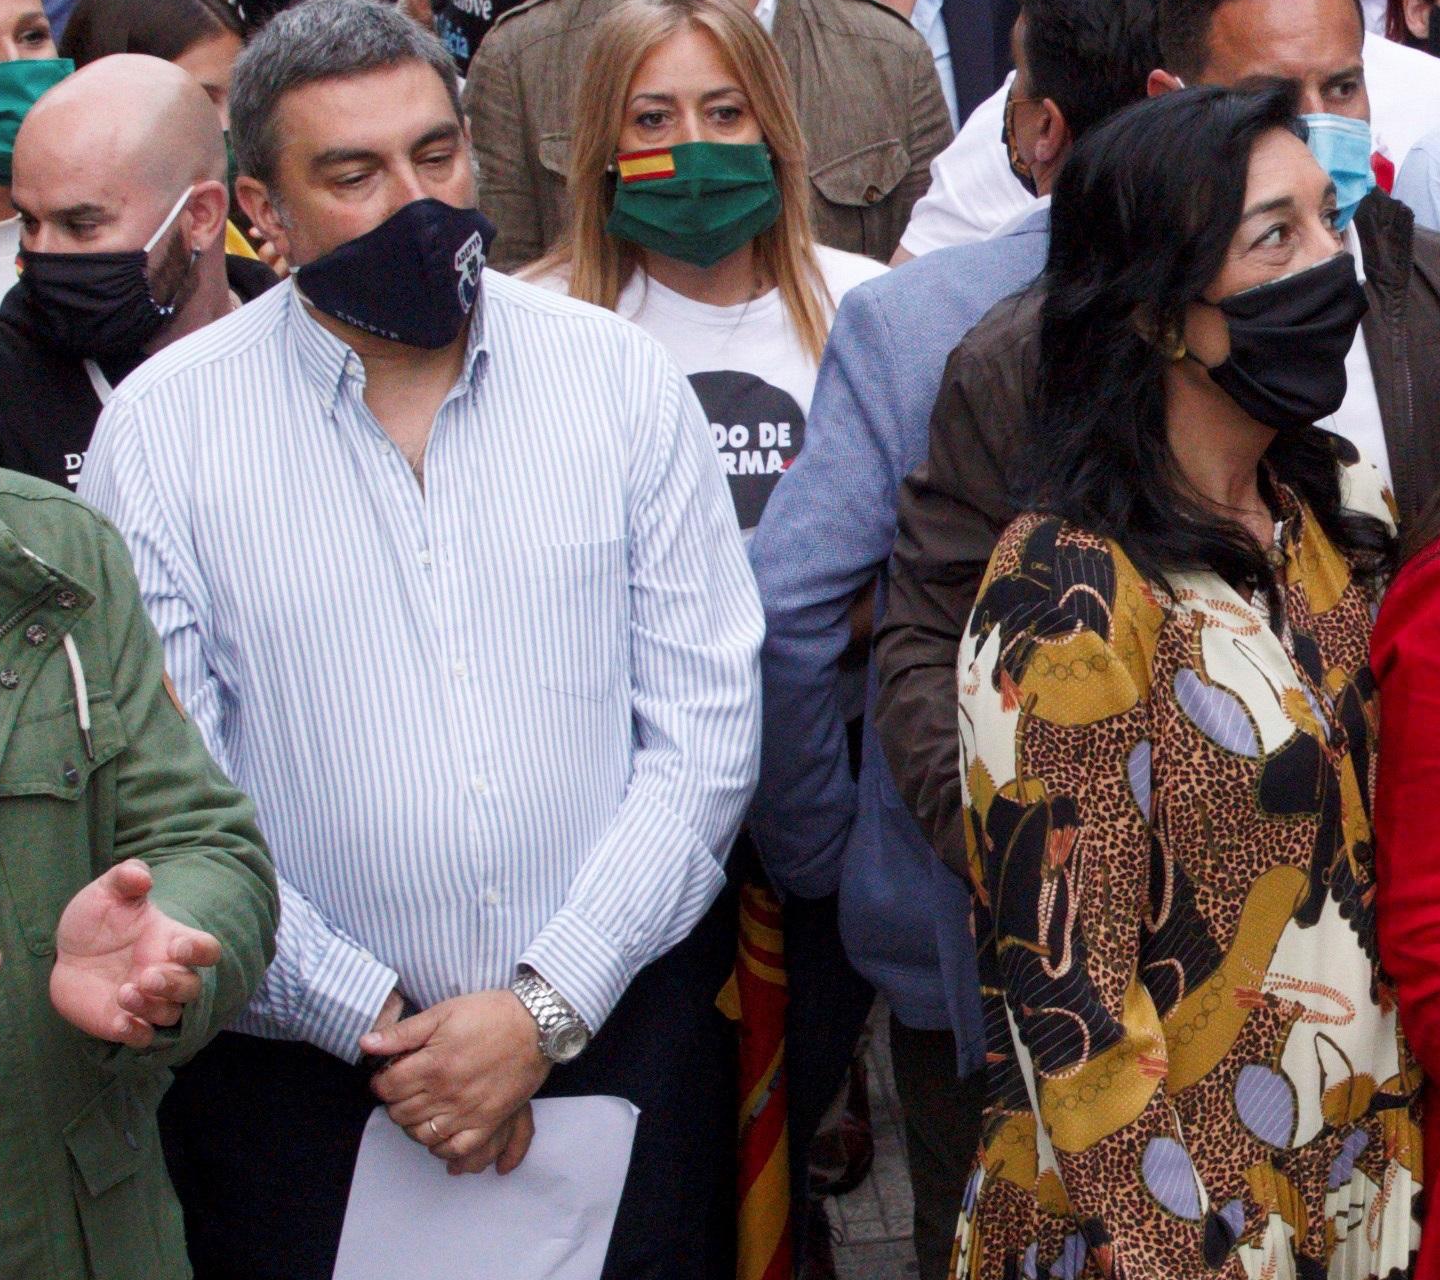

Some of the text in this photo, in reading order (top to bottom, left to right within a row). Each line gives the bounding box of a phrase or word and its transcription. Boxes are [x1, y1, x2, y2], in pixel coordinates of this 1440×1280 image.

[710, 422, 792, 448] DO DE
[718, 450, 786, 475] RMA
